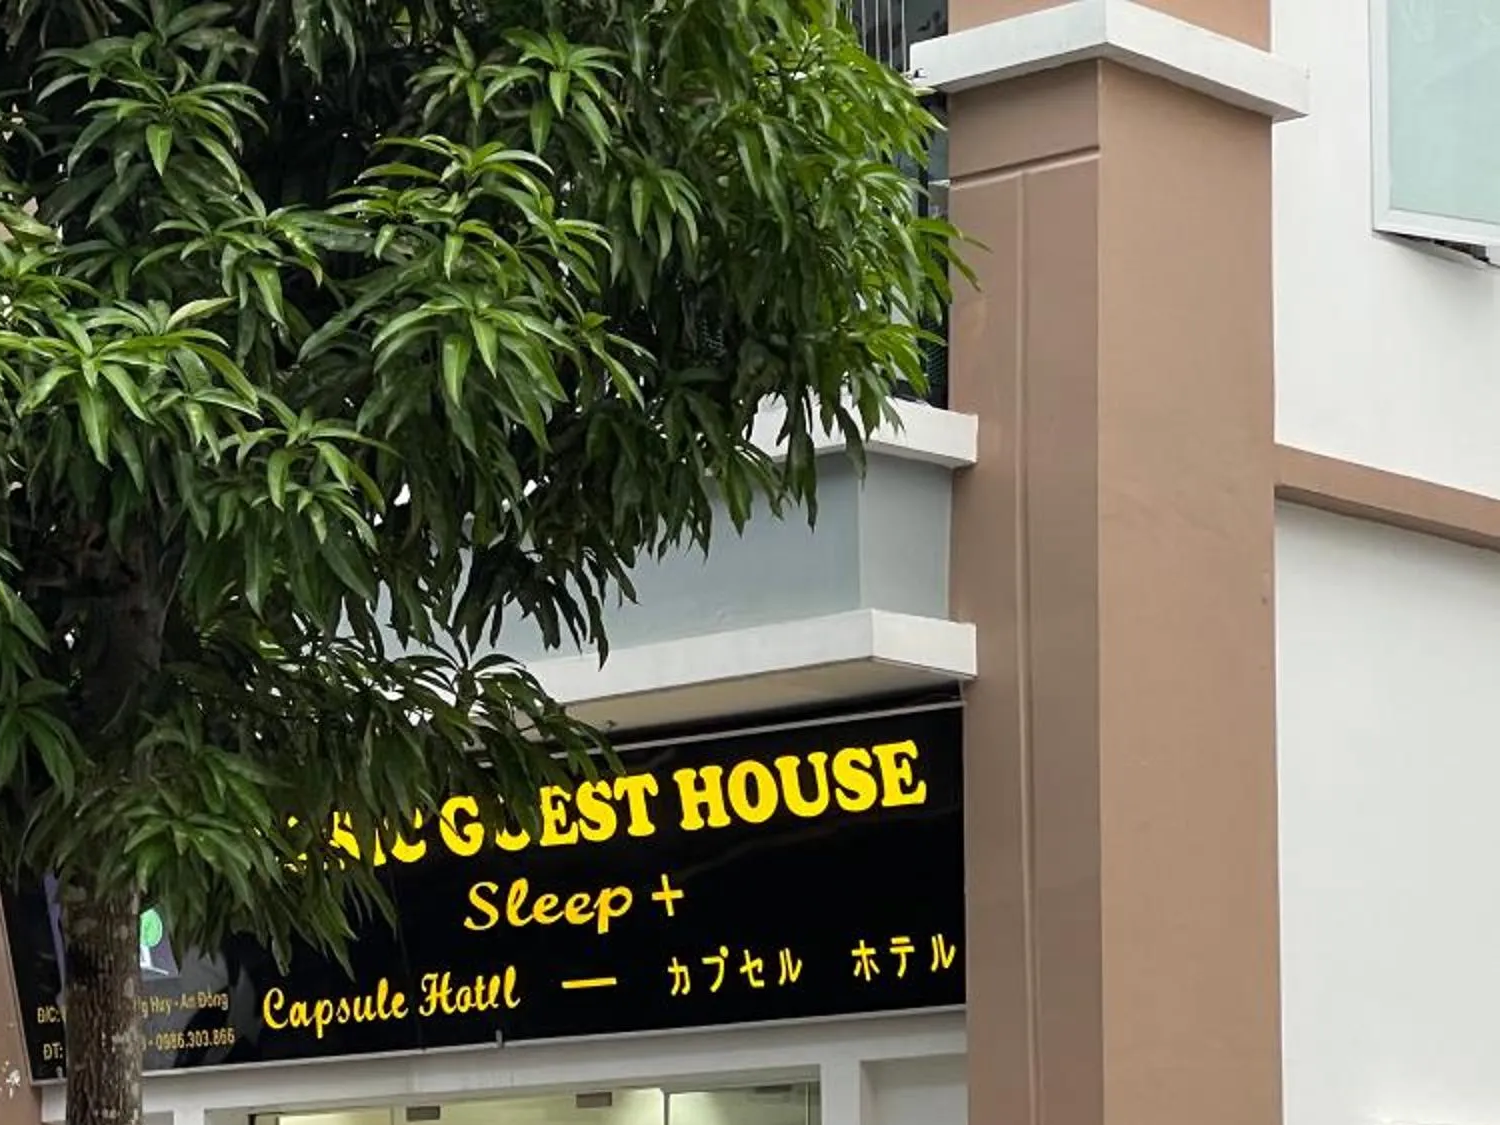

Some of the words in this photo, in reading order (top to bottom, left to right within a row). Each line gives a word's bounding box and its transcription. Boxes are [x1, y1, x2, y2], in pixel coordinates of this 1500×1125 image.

[673, 740, 927, 831] HOUSE
[463, 877, 633, 934] Sleep
[668, 946, 802, 996] カプセル
[851, 933, 956, 981] ホテル
[263, 977, 408, 1039] Capsule
